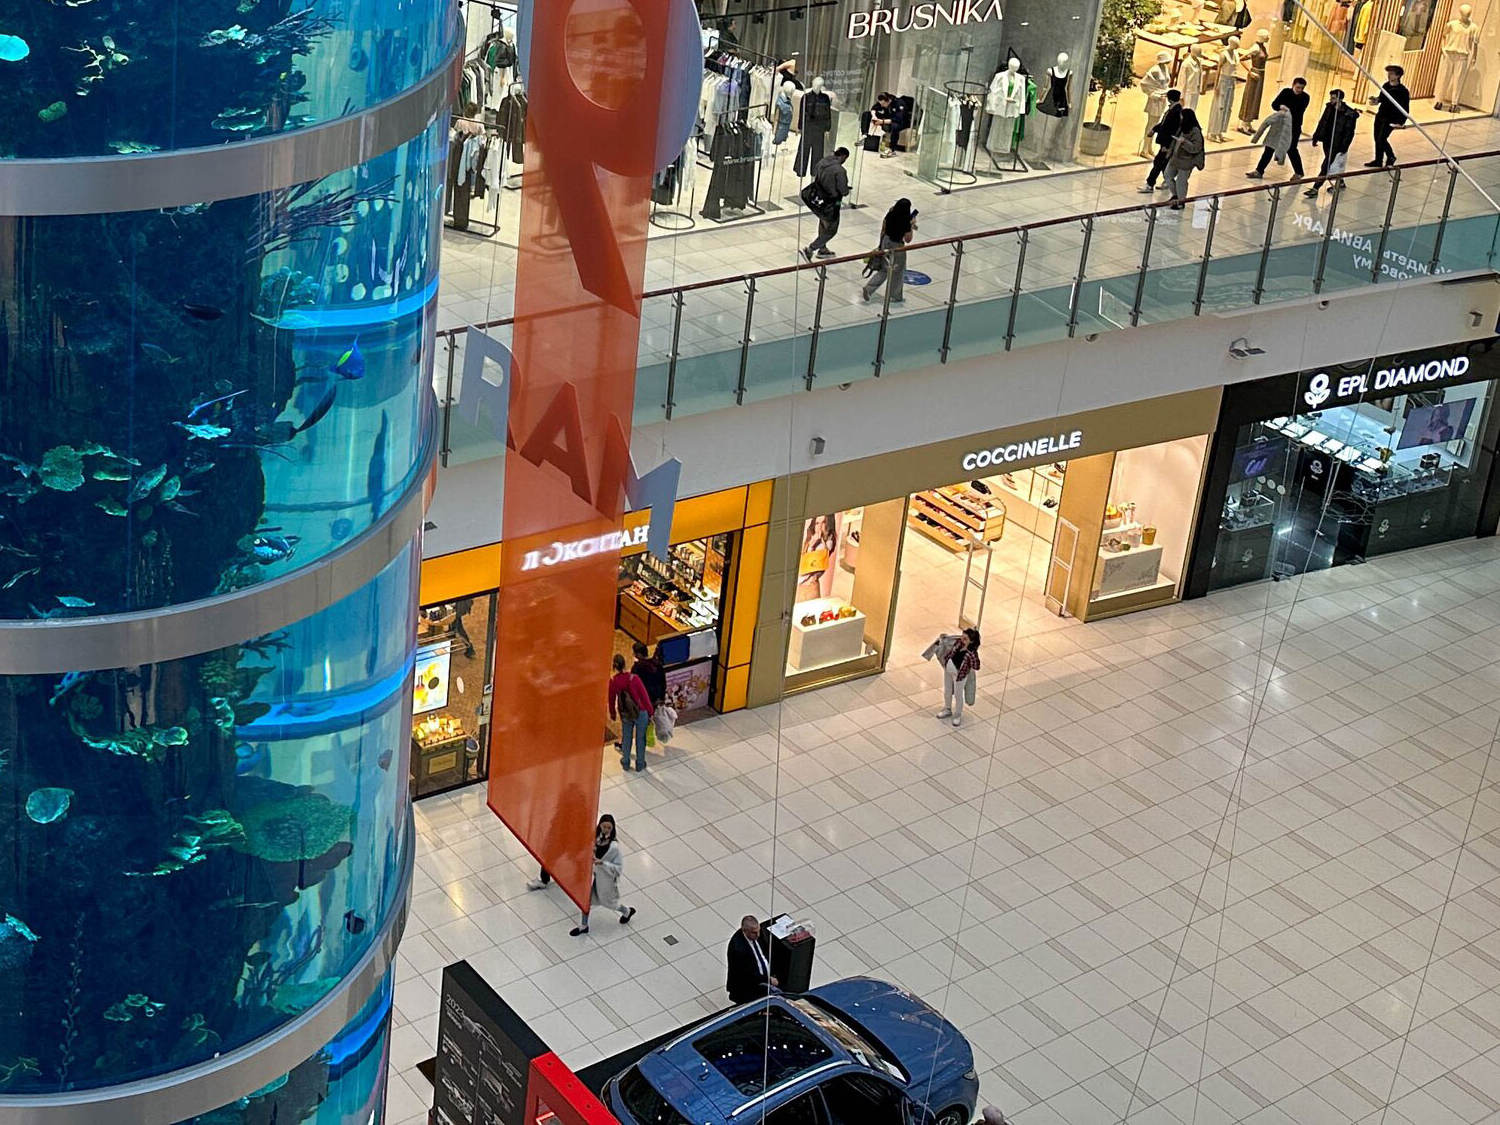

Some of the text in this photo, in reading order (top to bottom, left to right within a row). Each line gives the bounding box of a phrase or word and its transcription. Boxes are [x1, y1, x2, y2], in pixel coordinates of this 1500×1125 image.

[1337, 356, 1470, 398] EPL DIAMOND
[961, 430, 1083, 472] COCCINELLE
